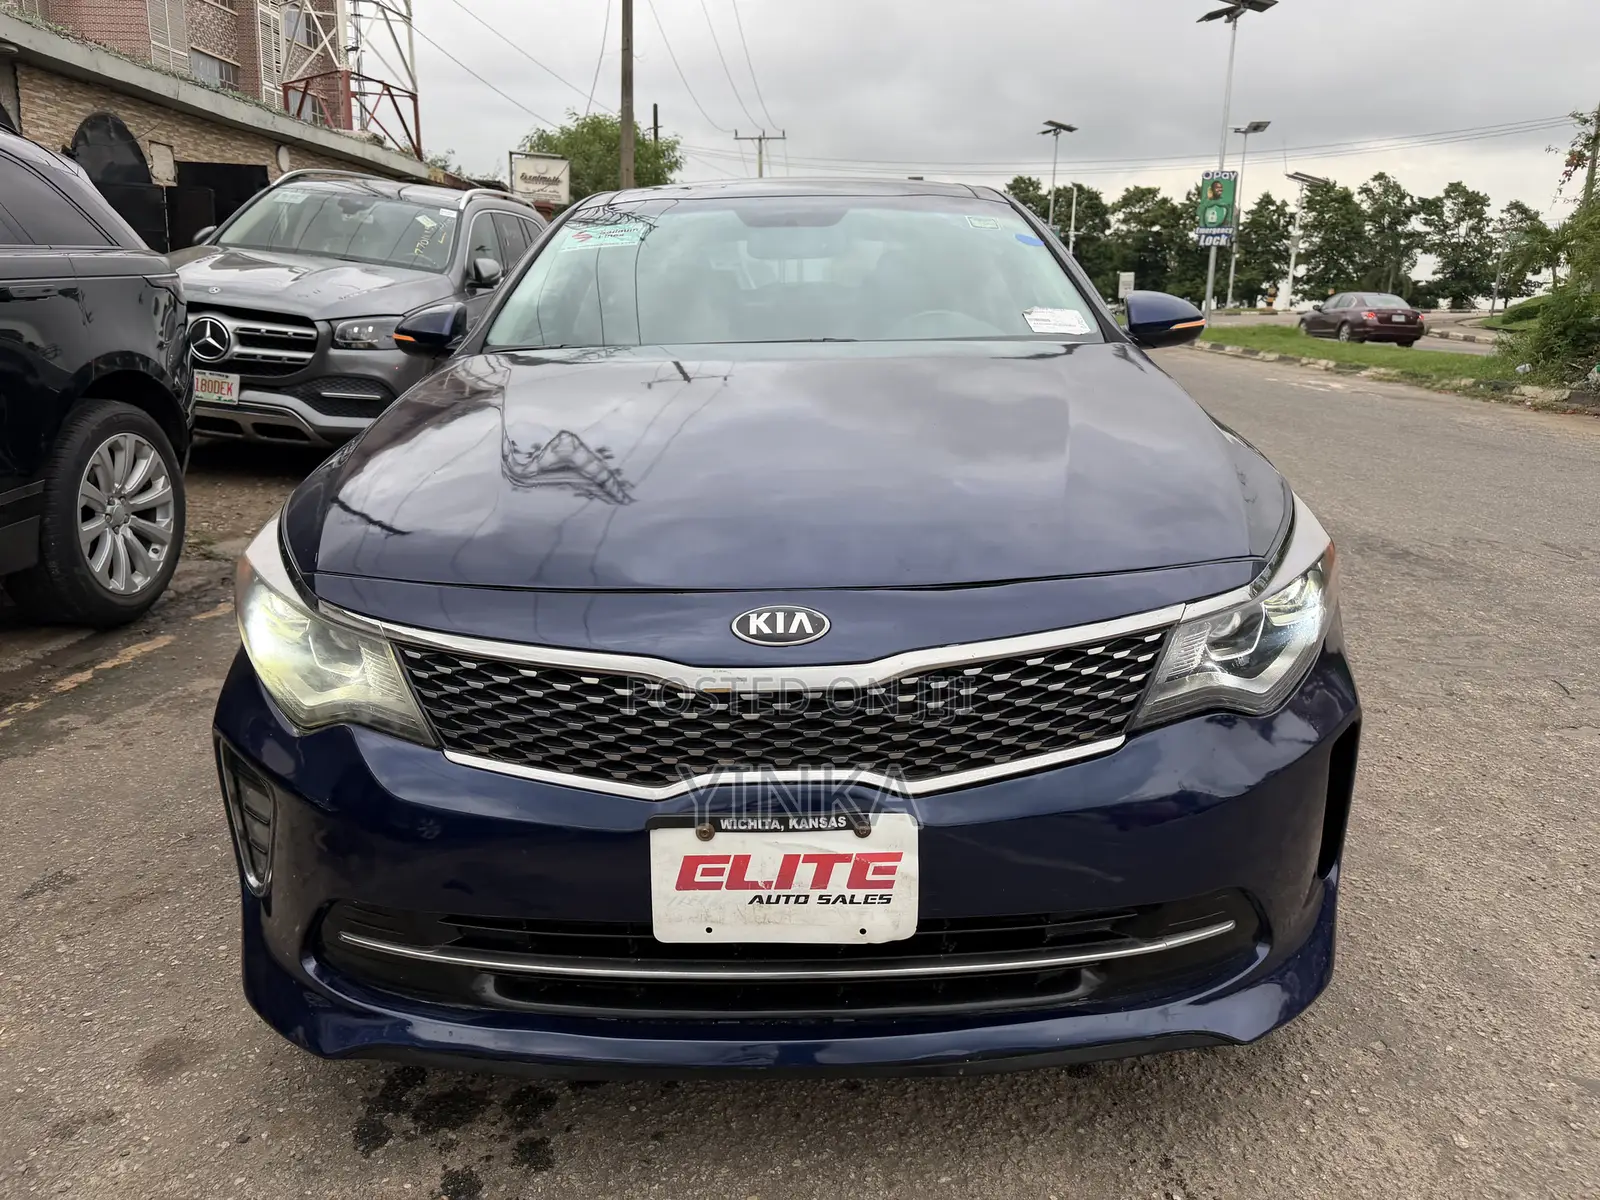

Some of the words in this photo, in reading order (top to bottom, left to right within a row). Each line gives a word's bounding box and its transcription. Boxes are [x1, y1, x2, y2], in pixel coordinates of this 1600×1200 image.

[1203, 171, 1237, 180] OPay
[1196, 227, 1233, 235] Emergency
[749, 611, 815, 635] KIA
[720, 817, 785, 832] WICHITA,
[789, 816, 847, 829] KANSAS
[674, 852, 904, 892] ELITE
[748, 894, 810, 905] AUTO
[816, 894, 893, 905] SALES
